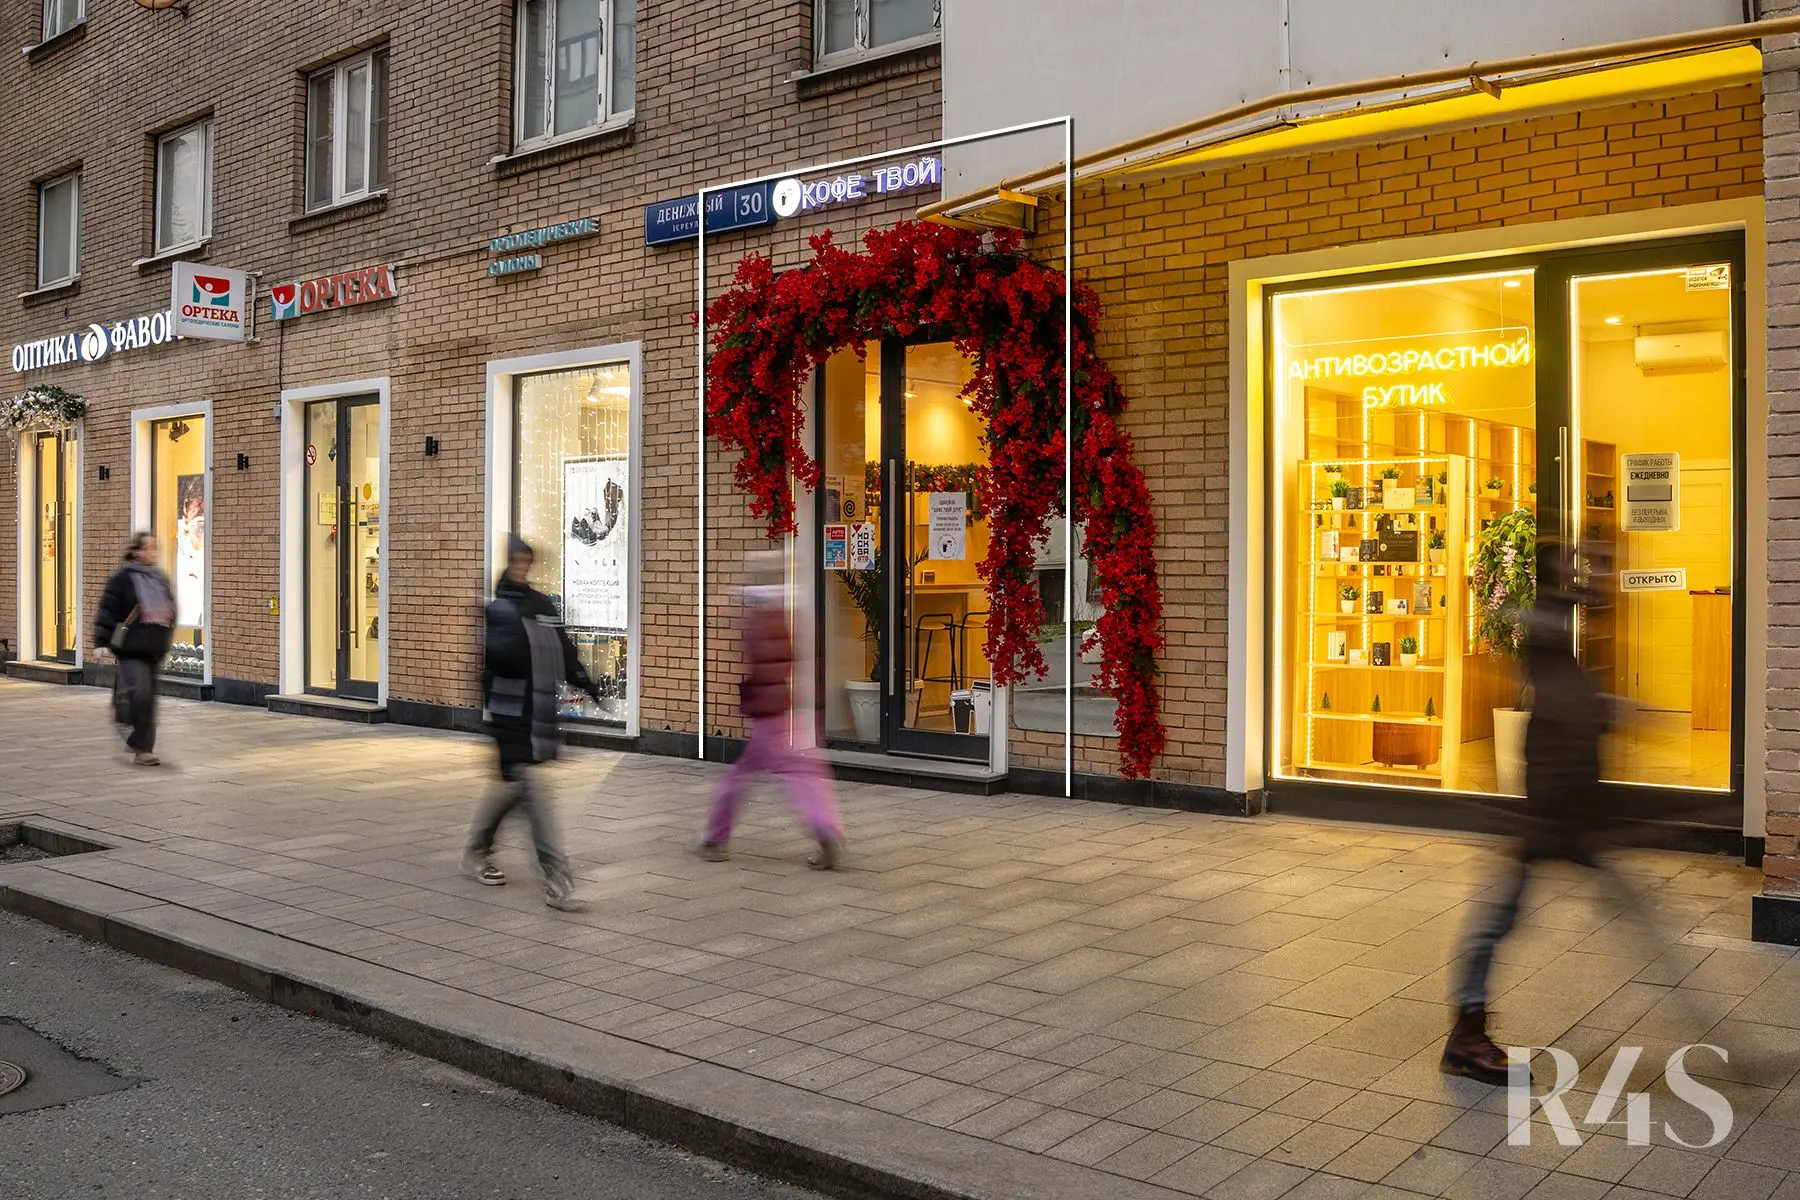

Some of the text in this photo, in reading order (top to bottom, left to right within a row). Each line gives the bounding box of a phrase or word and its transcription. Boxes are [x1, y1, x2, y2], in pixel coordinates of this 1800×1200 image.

[802, 157, 938, 209] КОФЕ ТВОЙ
[740, 192, 762, 216] 30
[300, 264, 393, 313] ОРТЕКА
[182, 304, 240, 322] ОРТЕКА
[12, 333, 78, 373] ОПТИКА
[1288, 337, 1531, 381] АНТИВОЗРАСТНОЙ
[1363, 383, 1447, 410] БУТИК
[1650, 458, 1673, 466] РАБОТЫ
[1630, 471, 1670, 480] ЕЖЕДНЕВНО
[1628, 575, 1677, 585] ОТКРЫТО
